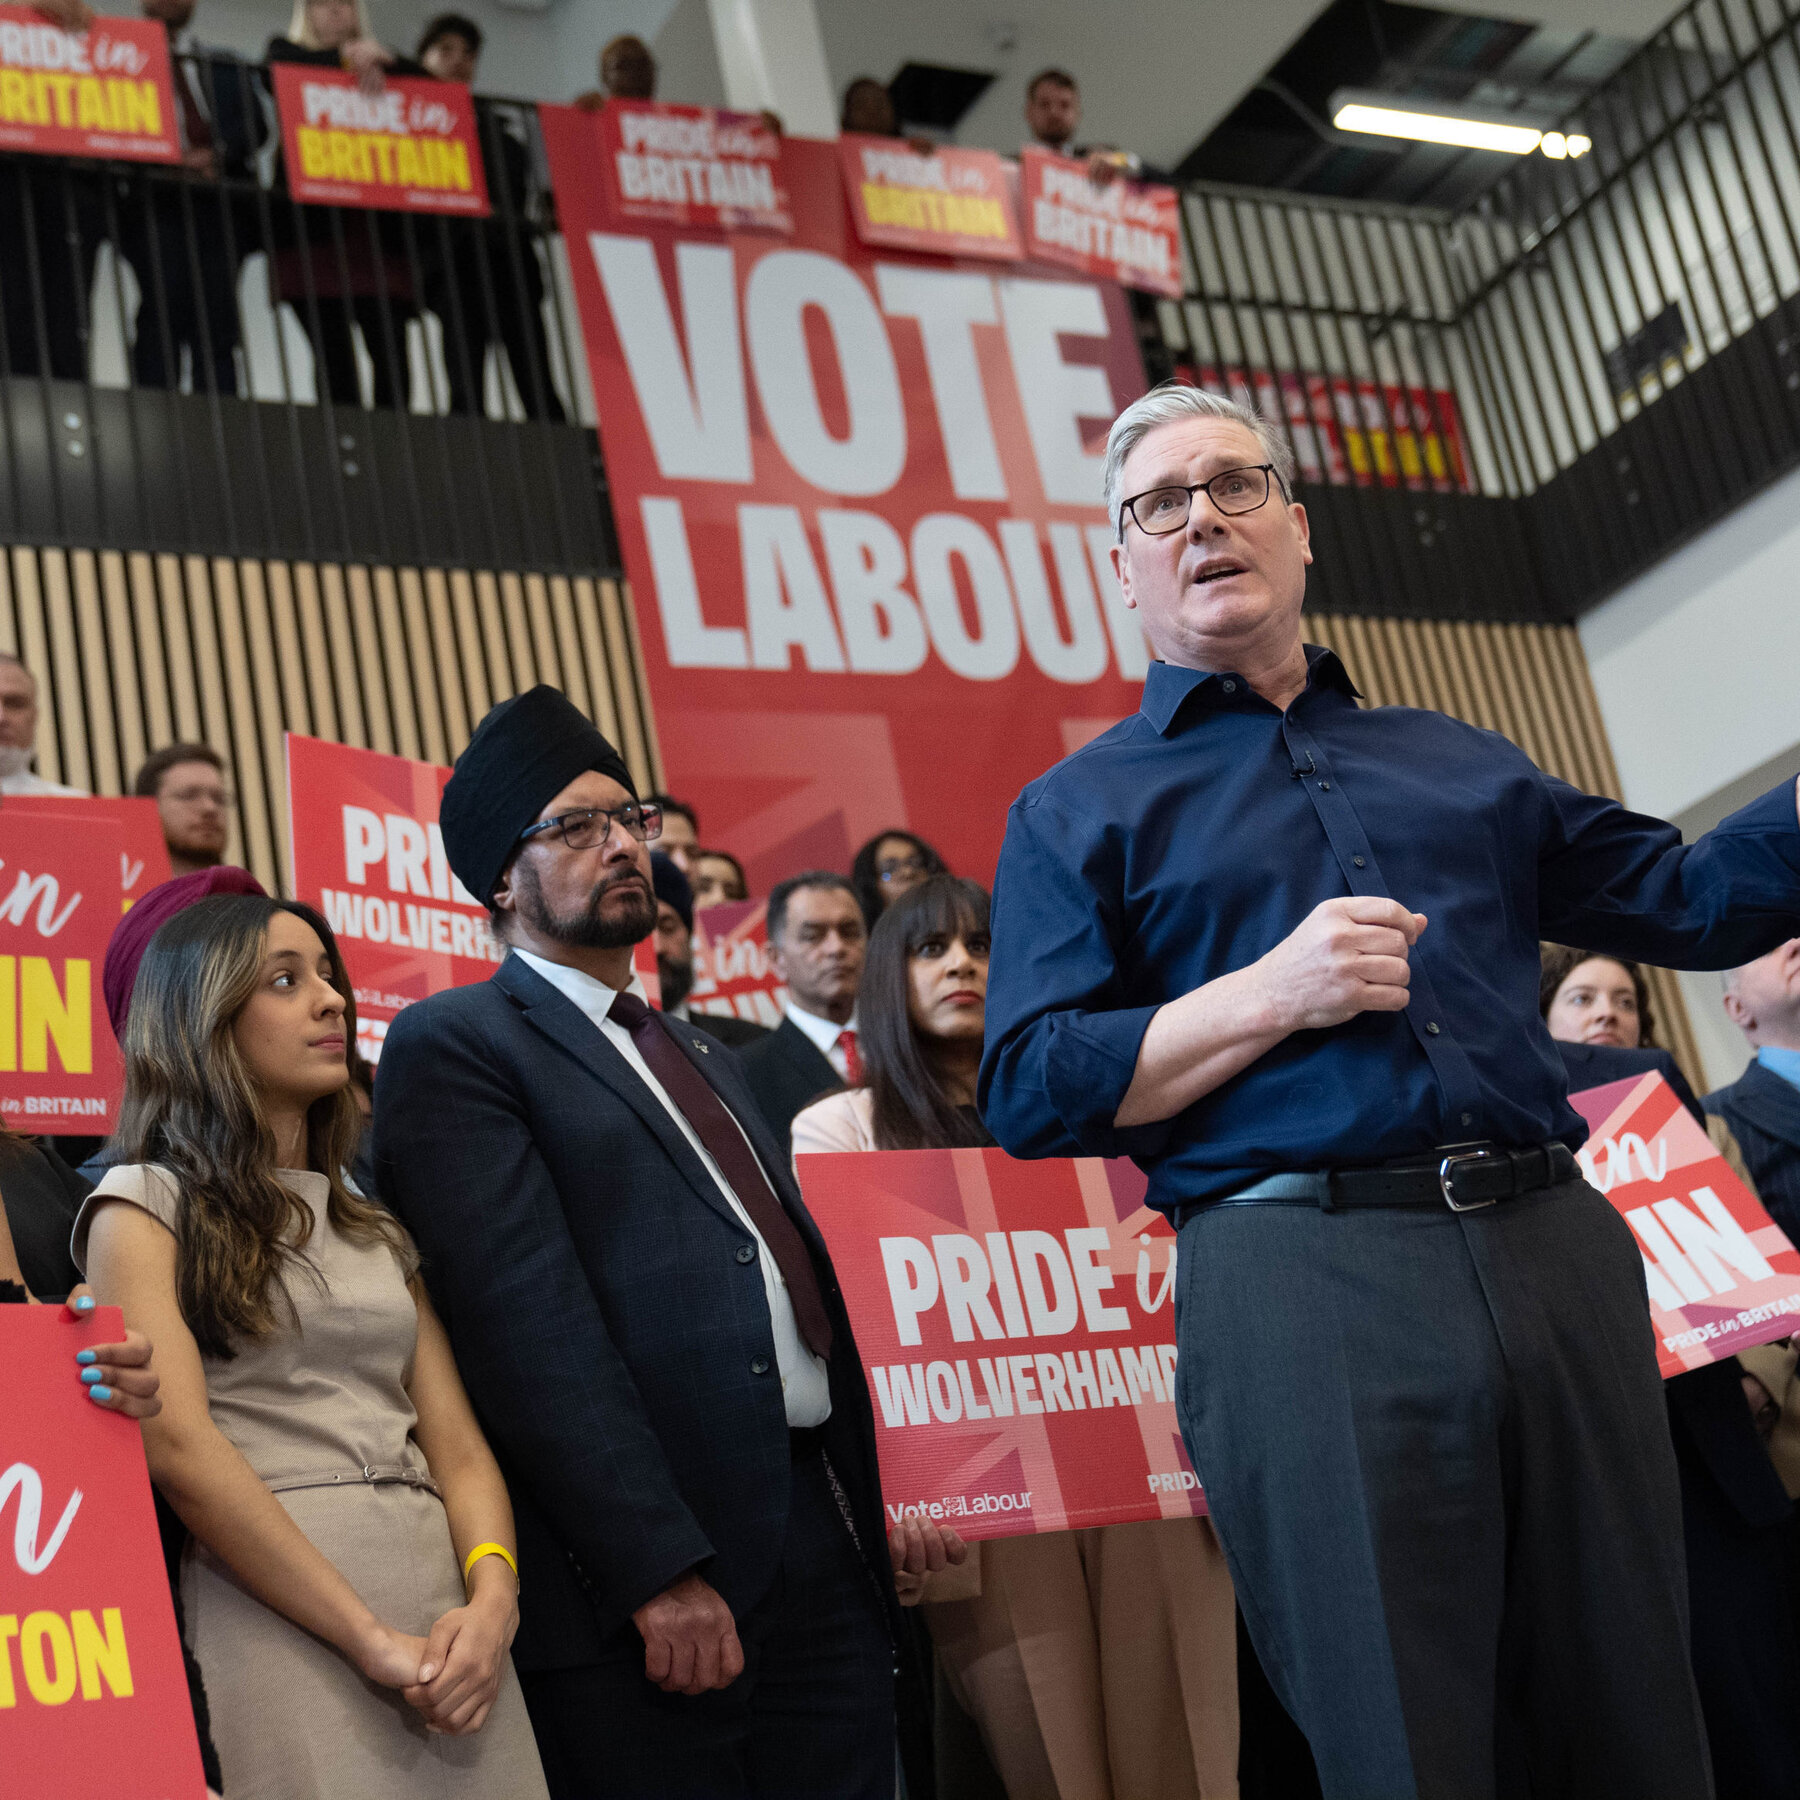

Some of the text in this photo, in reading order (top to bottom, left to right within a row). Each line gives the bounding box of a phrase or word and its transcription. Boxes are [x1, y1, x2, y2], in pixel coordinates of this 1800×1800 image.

[0, 20, 150, 76] RIDE in
[0, 68, 163, 136] RITAIN
[302, 83, 459, 135] PRIDE in
[297, 125, 472, 191] BRITAIN
[616, 152, 777, 212] BRITAIN
[1033, 197, 1169, 276] BRITAIN
[588, 232, 1115, 508] VOTE
[25, 1095, 107, 1116] BRITAIN
[879, 1227, 1132, 1347] PRIDE
[1662, 1321, 1722, 1354] PRIDE
[1718, 1317, 1741, 1336] in
[1736, 1293, 1800, 1329] BRITAI
[886, 1500, 944, 1525] Vote
[961, 1491, 1033, 1516] Labour
